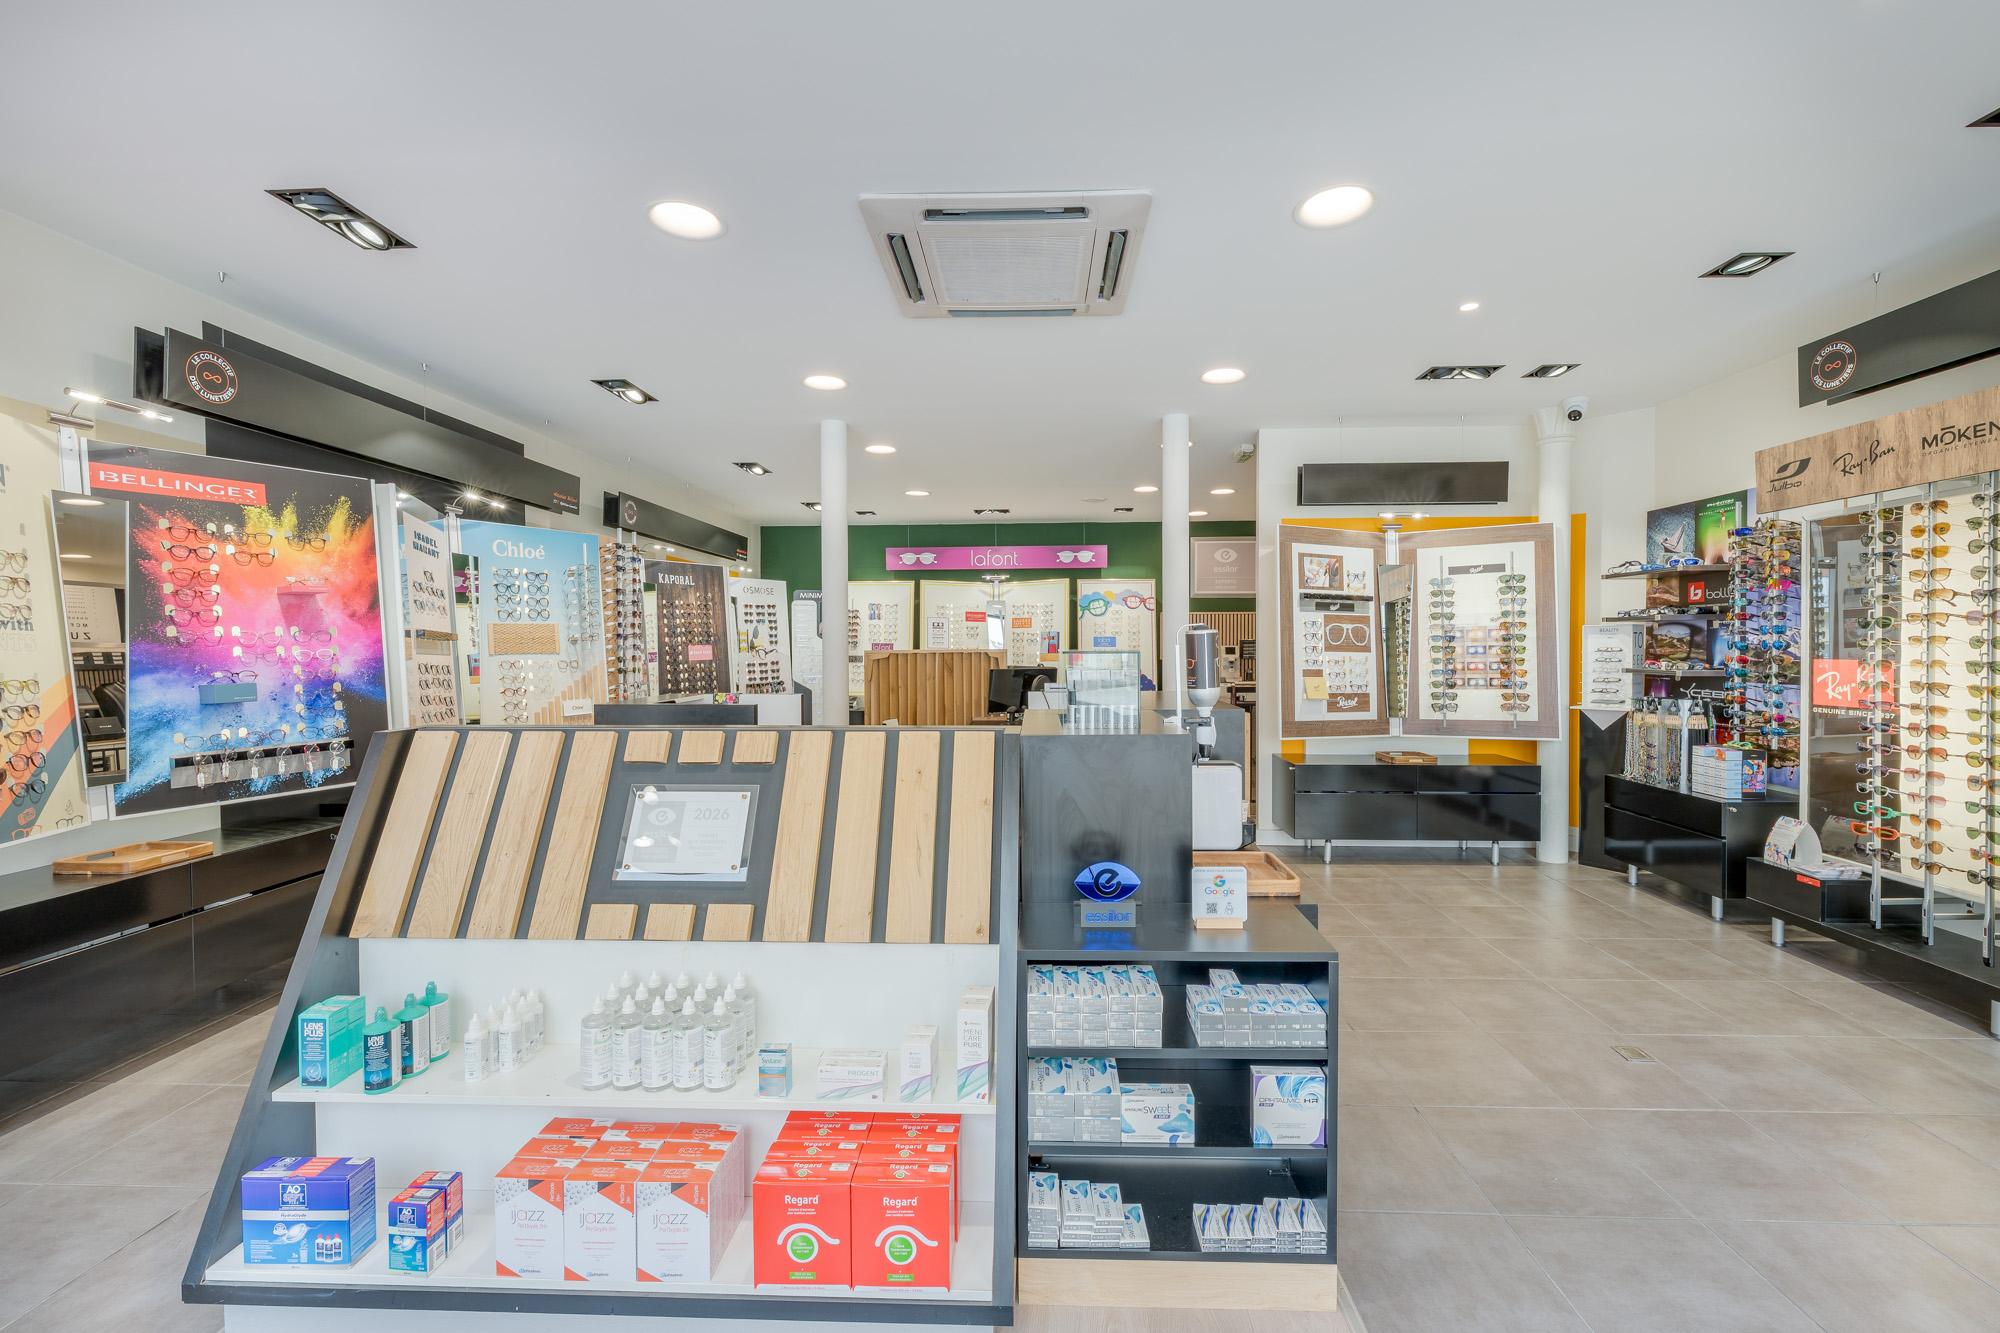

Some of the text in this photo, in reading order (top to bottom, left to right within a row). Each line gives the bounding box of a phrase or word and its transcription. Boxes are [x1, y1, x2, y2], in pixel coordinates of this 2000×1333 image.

[1814, 343, 1853, 365] LE COLLECTIF
[191, 353, 235, 377] LE COLLECTIF
[1813, 363, 1854, 388] DES LUNETIERS
[189, 375, 235, 402] DES LUNETIERS
[99, 470, 257, 499] BELLINGER
[1768, 480, 1802, 493] Julbo
[413, 530, 438, 548] ISABEL
[412, 540, 440, 559] MARANT
[492, 539, 546, 560] Chloé
[658, 572, 695, 586] KAPORAL
[742, 586, 775, 596] OSMOSE
[1812, 707, 1847, 715] GENUINE
[1848, 709, 1873, 717] SINCE
[693, 807, 730, 821] 2026
[1204, 886, 1236, 897] Google
[1085, 908, 1133, 923] essilor
[303, 1022, 324, 1030] LENS
[303, 1029, 324, 1037] PLUS
[1143, 1103, 1171, 1114] sweet
[286, 1185, 301, 1194] AO
[784, 1194, 819, 1207] Regard
[883, 1196, 918, 1209] Regard
